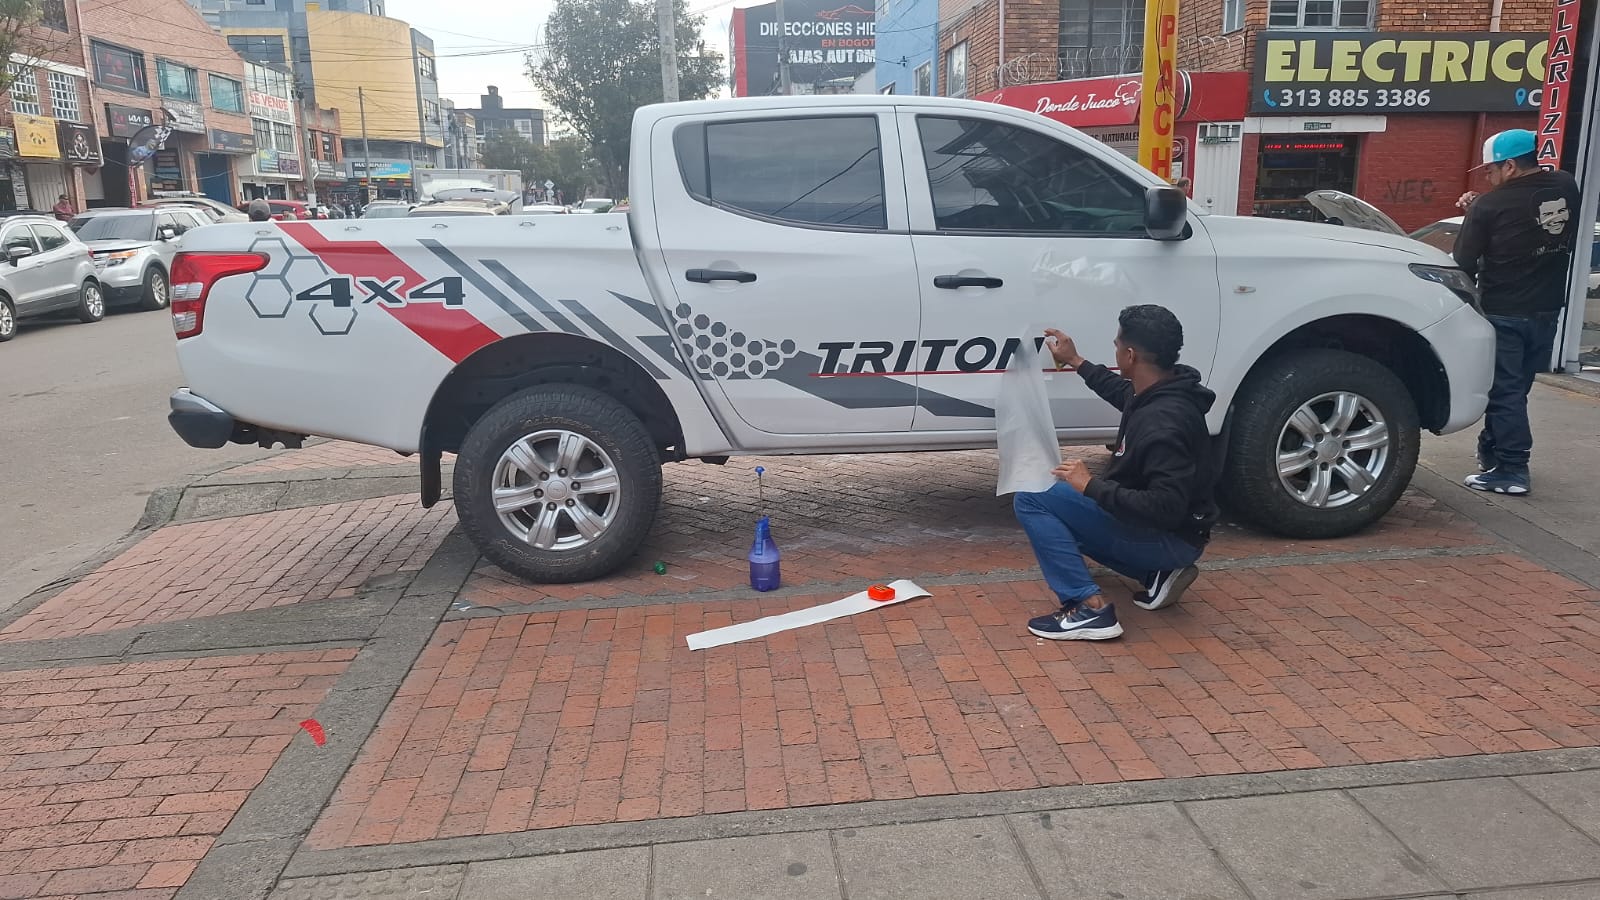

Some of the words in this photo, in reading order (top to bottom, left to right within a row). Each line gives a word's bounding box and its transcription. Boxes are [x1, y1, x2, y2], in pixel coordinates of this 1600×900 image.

[821, 39, 836, 48] EN
[777, 49, 823, 64] AJAS
[250, 91, 260, 105] SE
[261, 94, 289, 112] VENDE
[1034, 95, 1079, 115] Donde
[1081, 93, 1120, 111] Juaco
[1279, 89, 1321, 107] 313
[1327, 89, 1369, 107] 885
[1375, 89, 1431, 107] 3386
[817, 336, 1046, 374] TRITON
